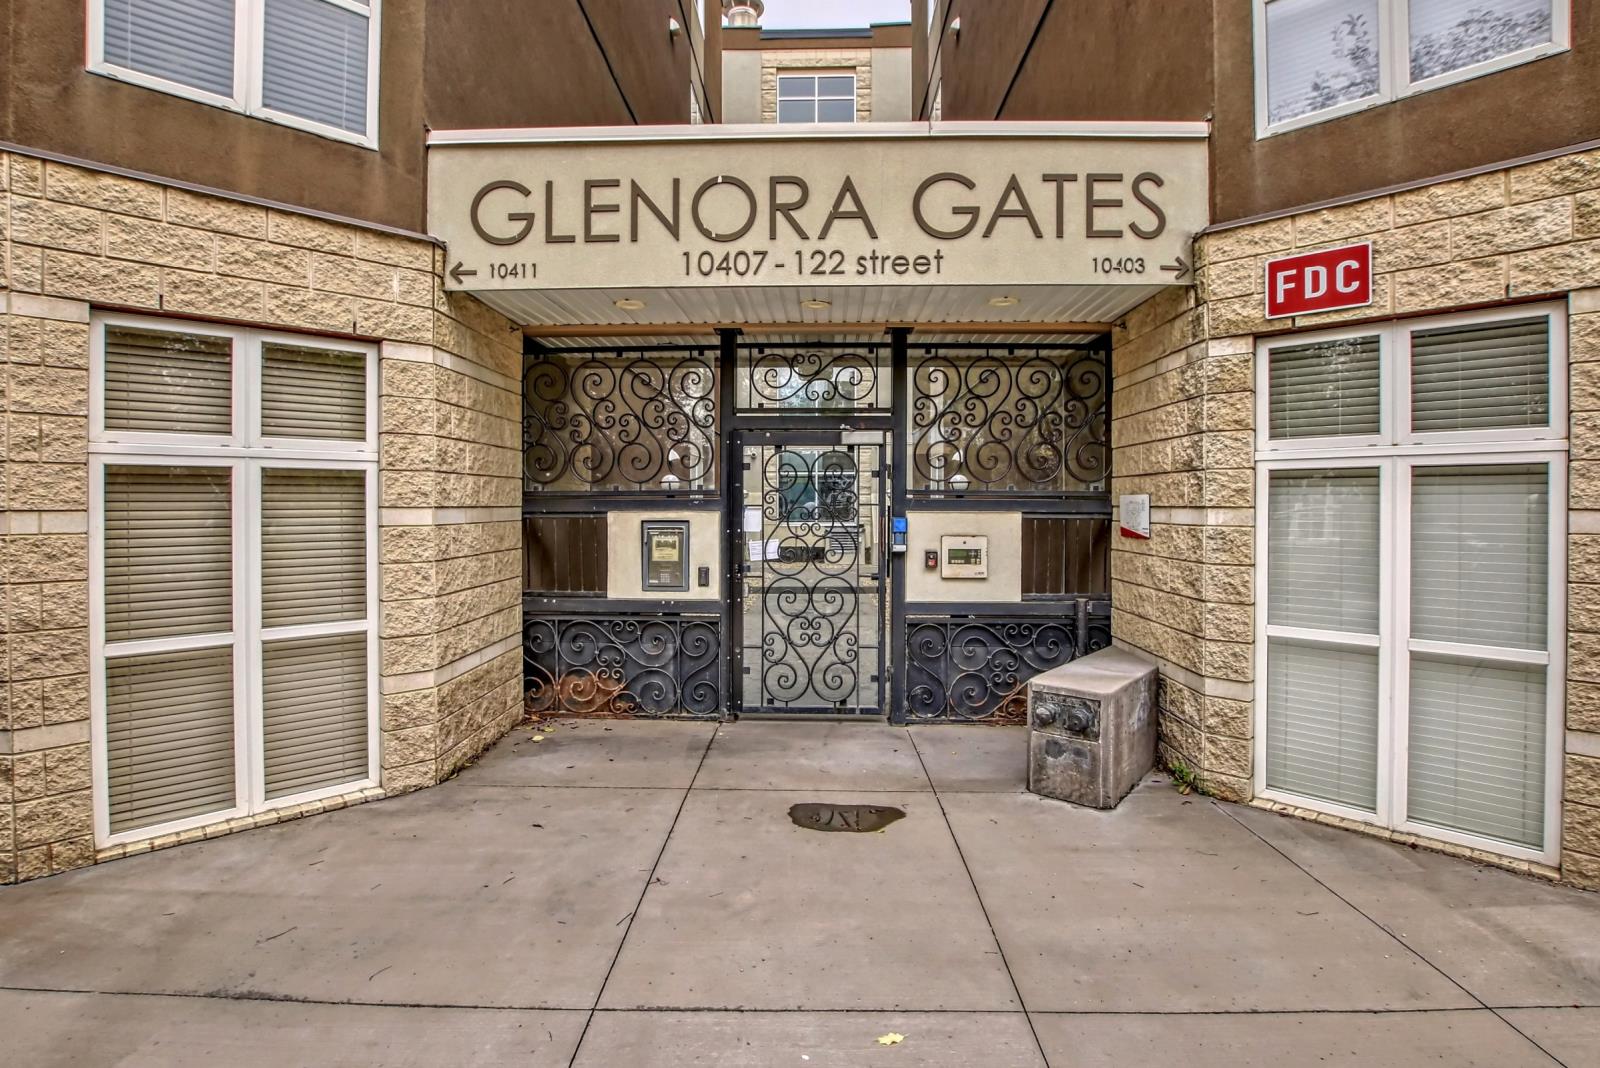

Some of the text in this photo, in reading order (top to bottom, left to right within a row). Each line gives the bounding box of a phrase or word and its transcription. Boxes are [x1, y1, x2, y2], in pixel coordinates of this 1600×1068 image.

[470, 172, 1167, 246] GLENORA GATES
[489, 263, 537, 280] 10411
[856, 248, 945, 276] street
[1092, 257, 1146, 274] 10403
[1276, 259, 1361, 304] FDC
